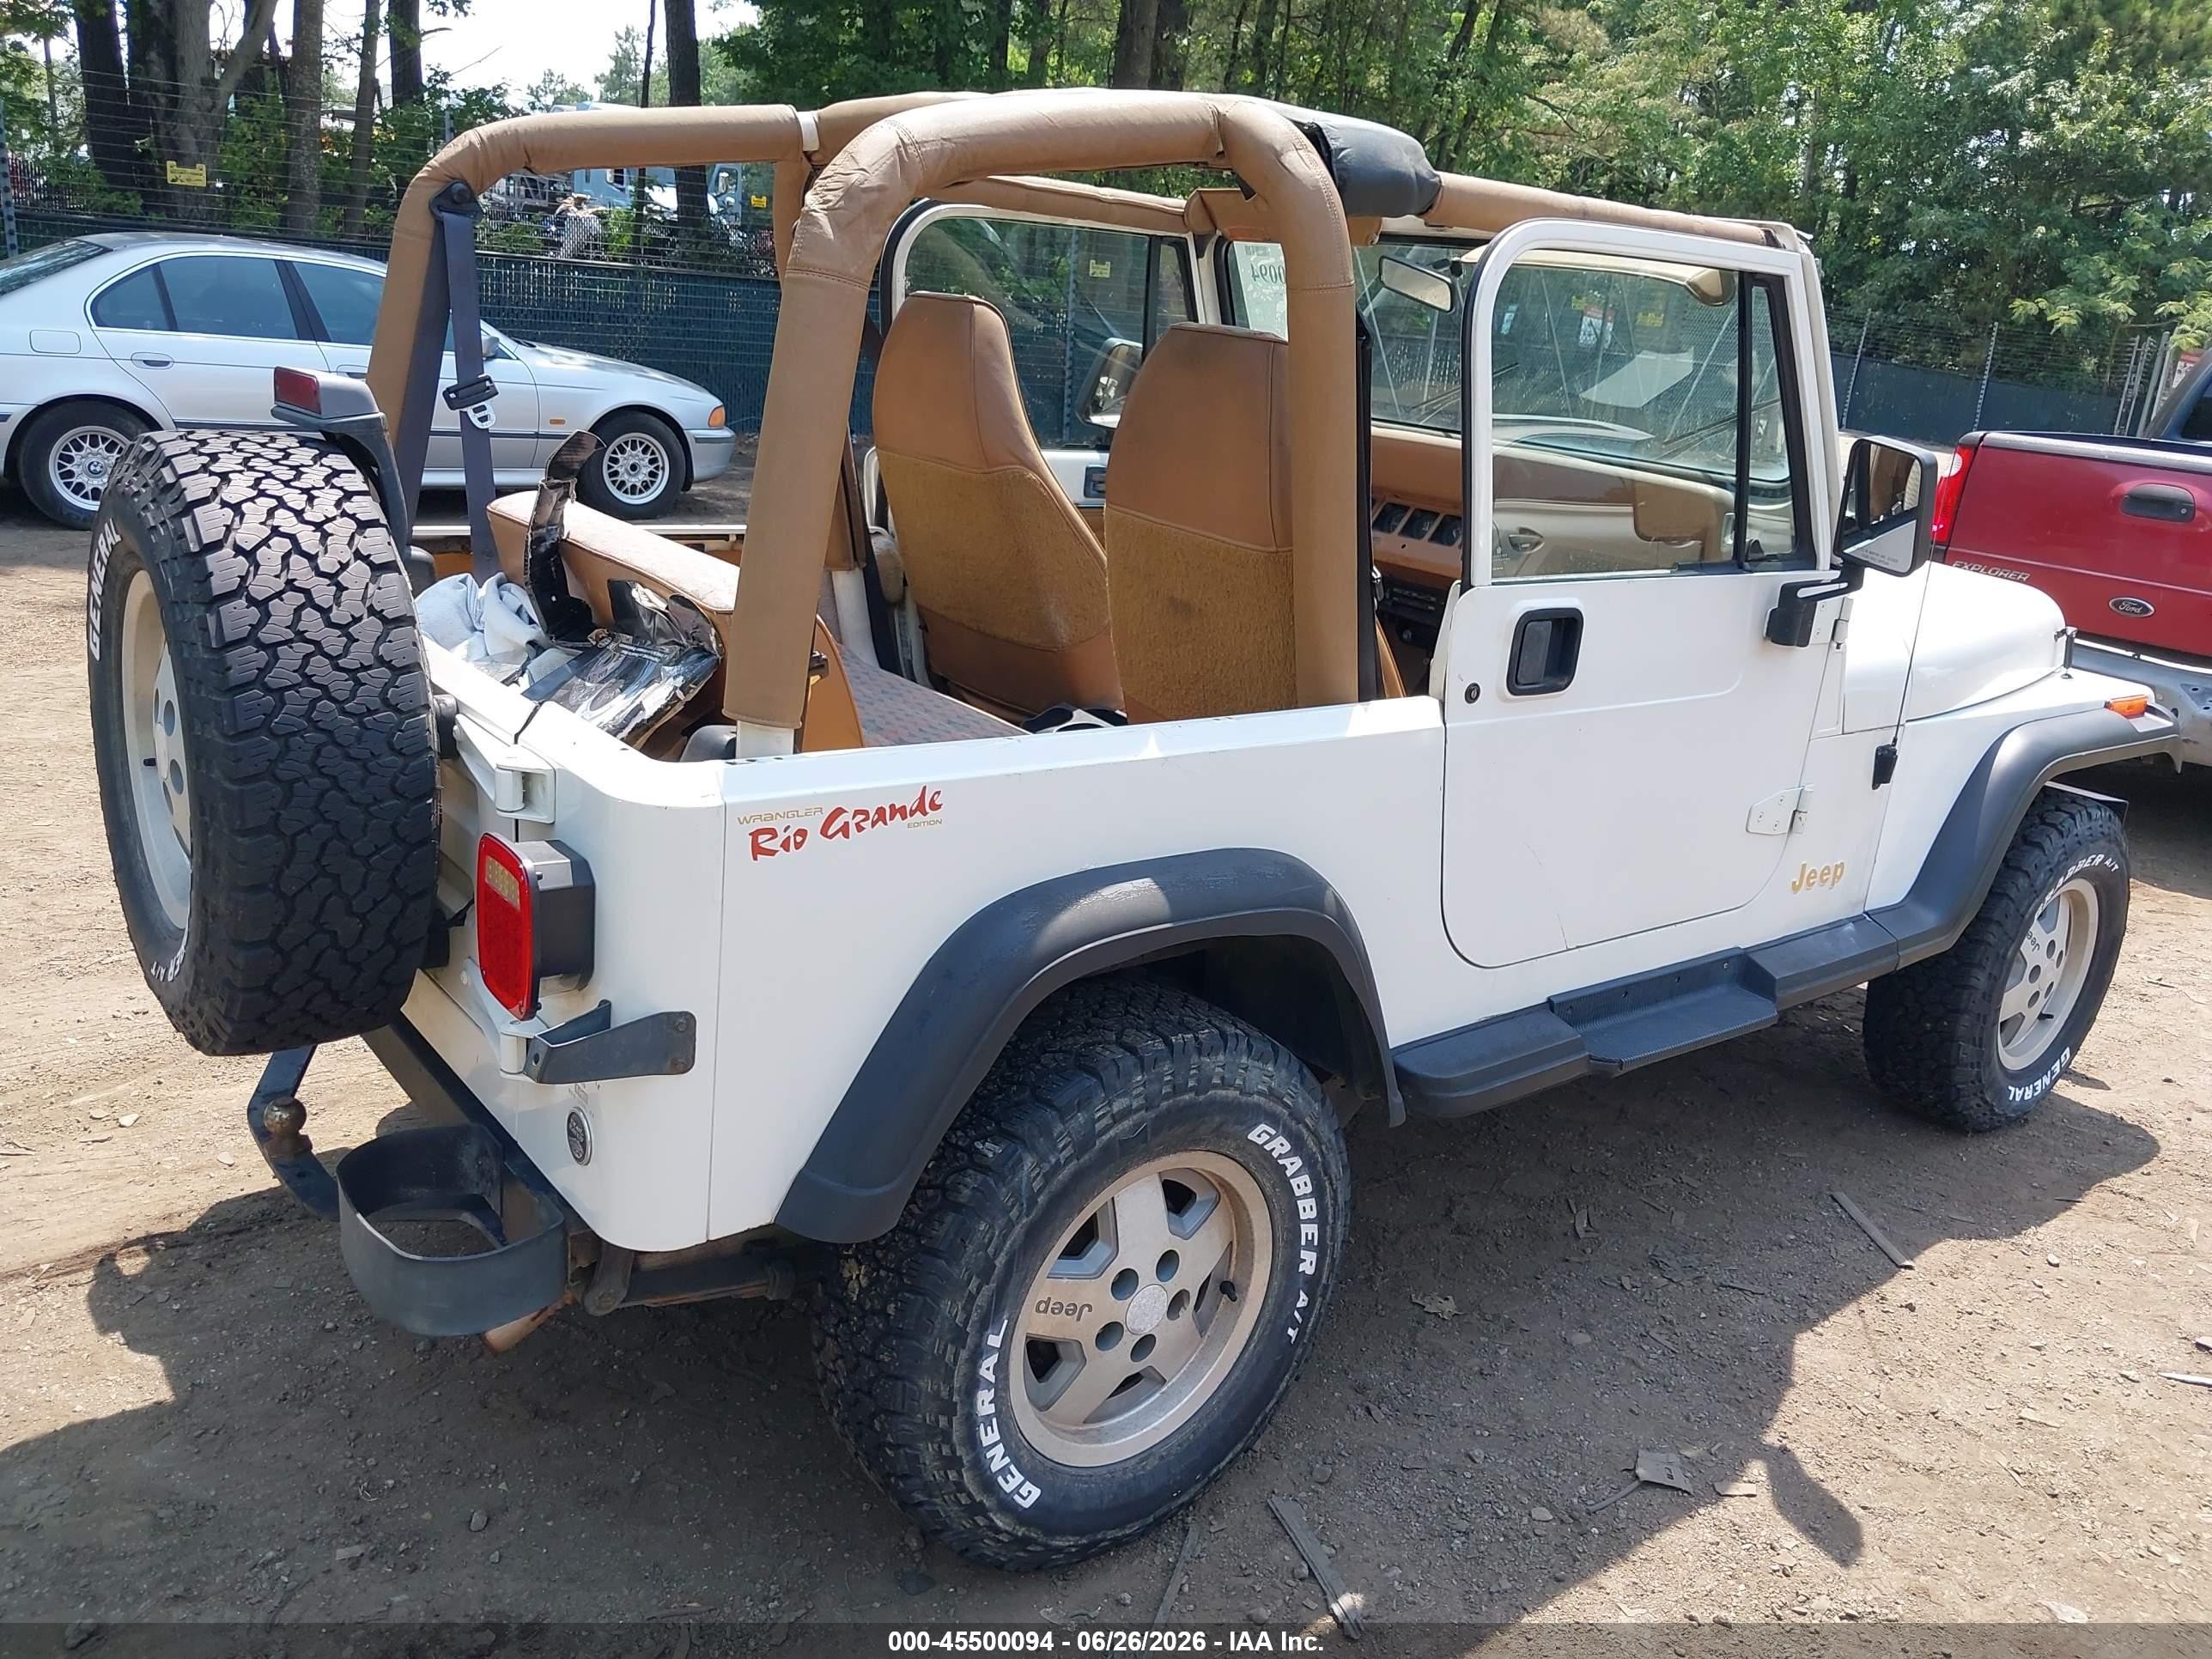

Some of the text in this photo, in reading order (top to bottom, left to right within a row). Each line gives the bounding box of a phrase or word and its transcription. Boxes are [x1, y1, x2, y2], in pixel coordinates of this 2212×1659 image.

[1953, 561, 2031, 581] EXPLORER
[90, 518, 123, 661] GENERAL
[2118, 601, 2143, 613] Ford
[737, 806, 824, 825] WRANGLER
[749, 785, 944, 861] Rio Grande
[907, 818, 943, 829] EDITION
[1791, 861, 1844, 892] Jeep
[2027, 931, 2040, 952] Jee
[2008, 1047, 2070, 1101] GENERAL
[1248, 1123, 1319, 1345] GRABBER A/T
[1035, 1297, 1093, 1322] Jeep
[979, 1319, 1042, 1509] GENERAL
